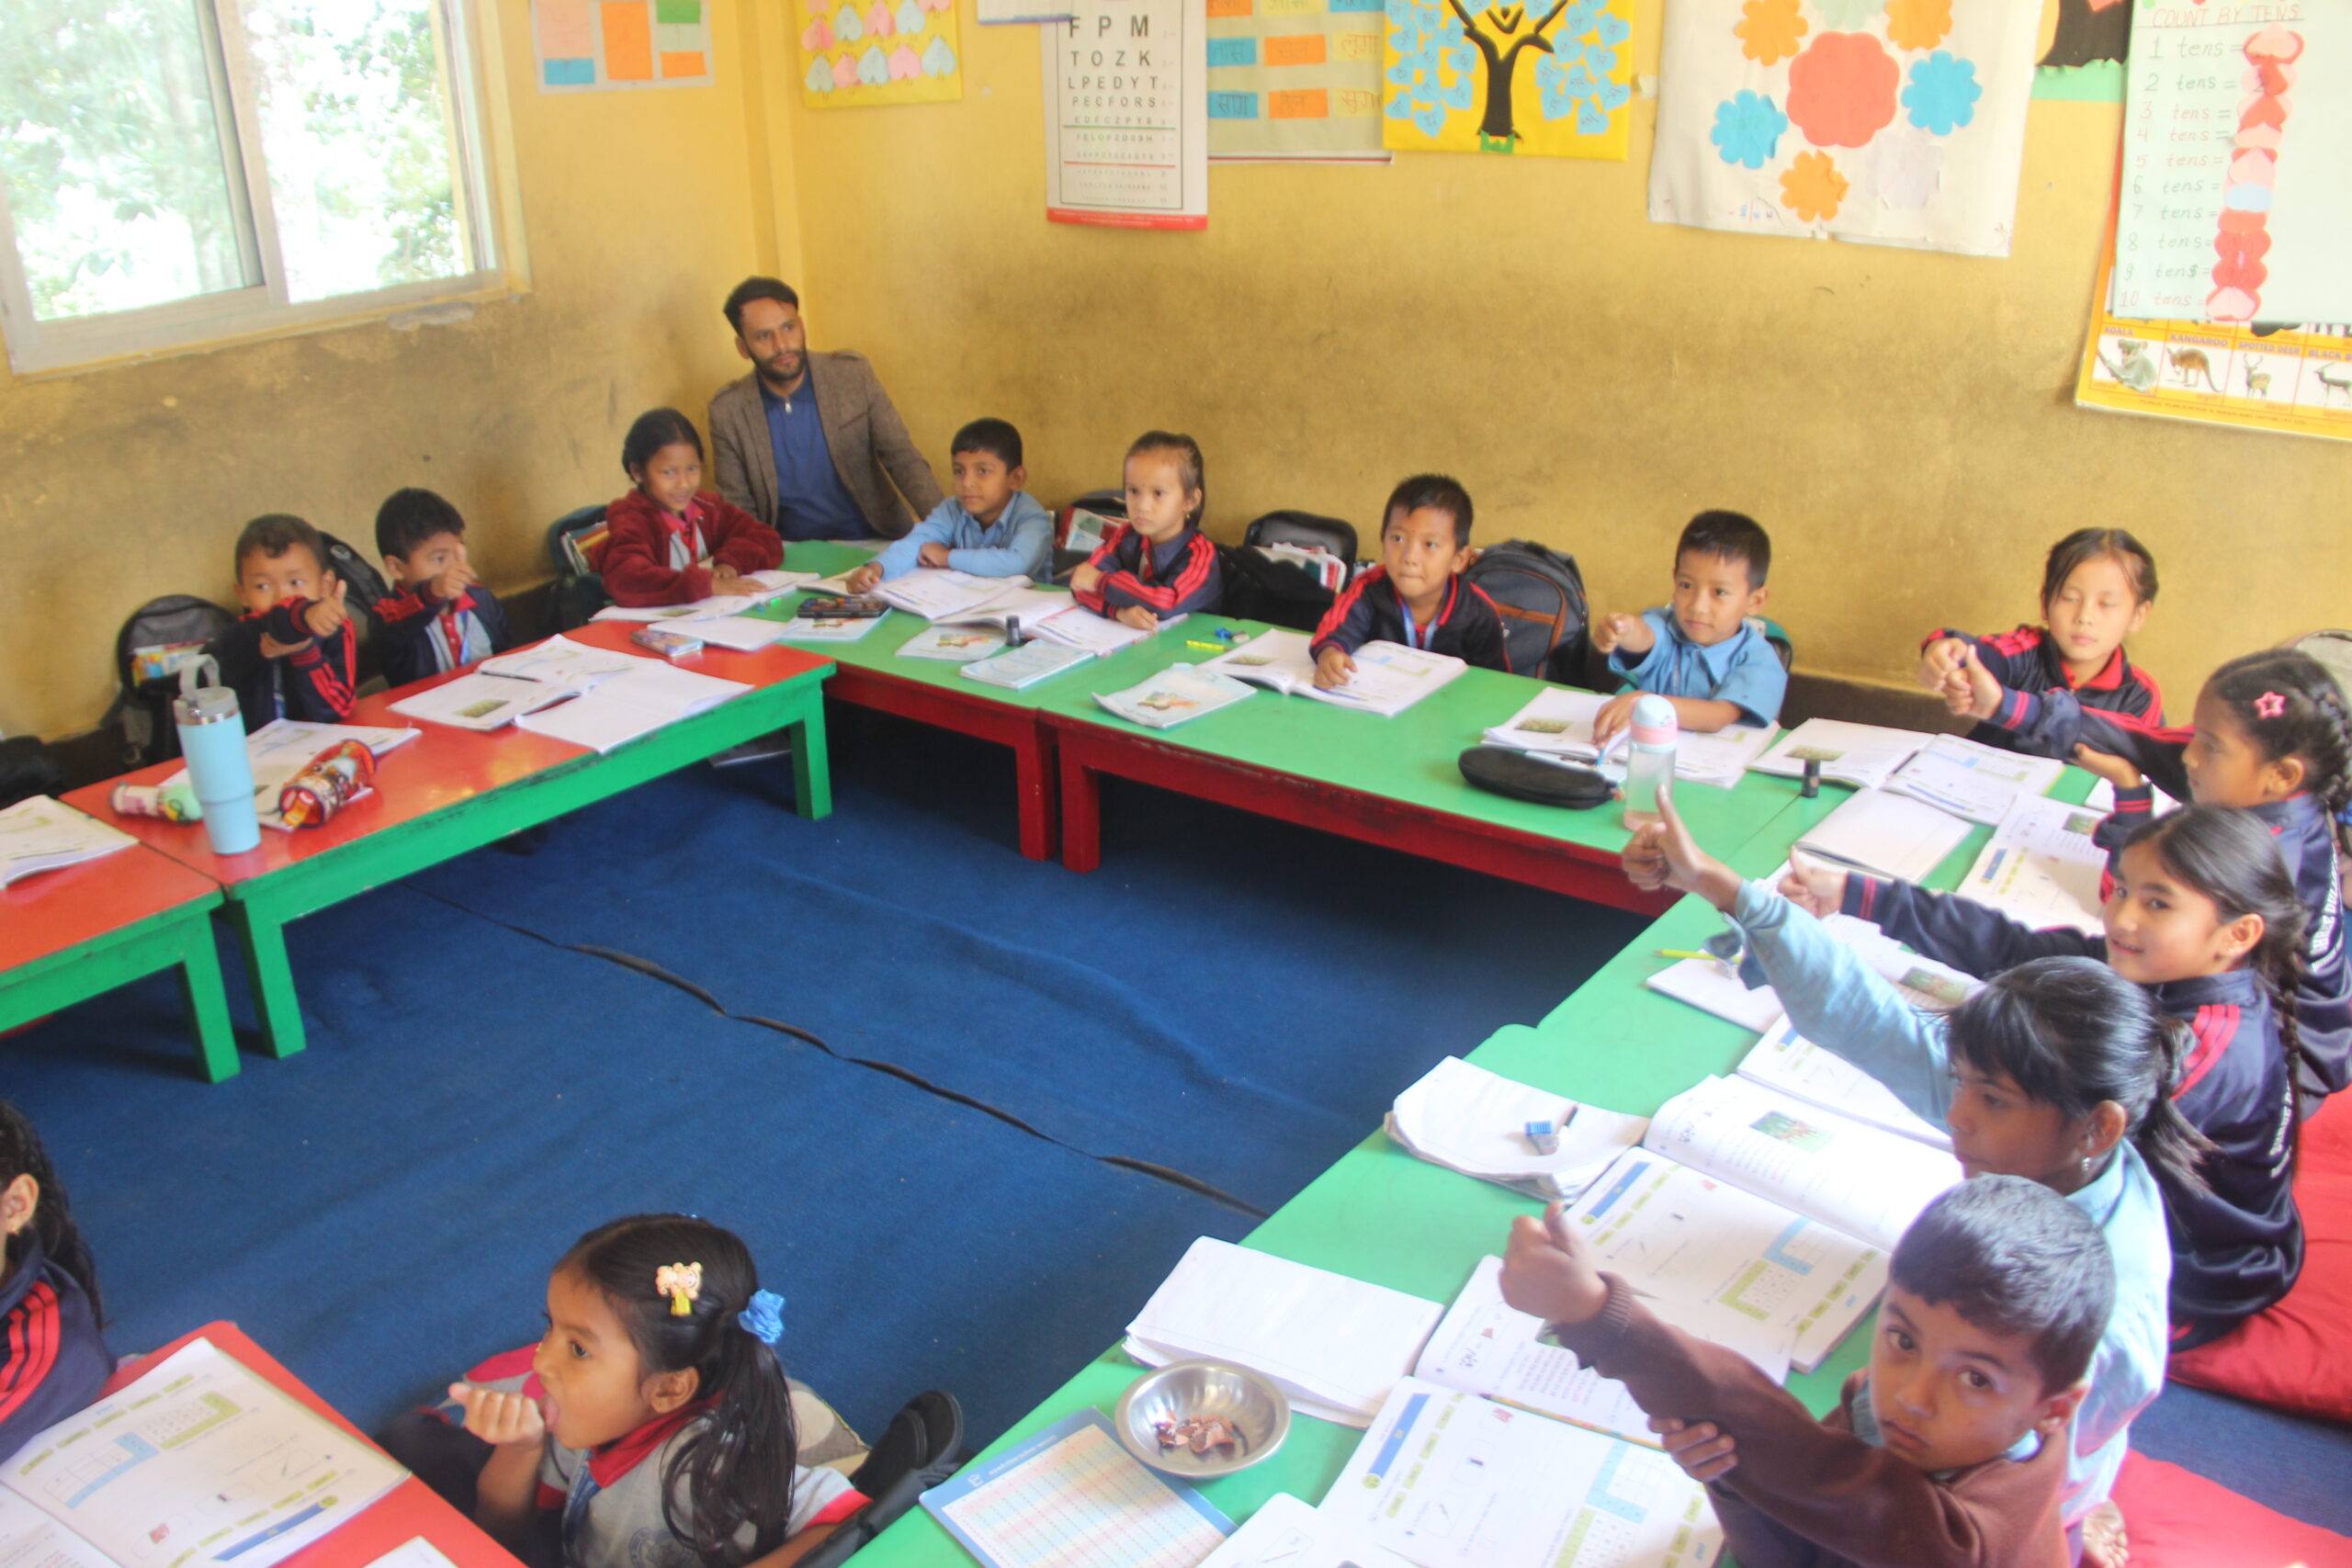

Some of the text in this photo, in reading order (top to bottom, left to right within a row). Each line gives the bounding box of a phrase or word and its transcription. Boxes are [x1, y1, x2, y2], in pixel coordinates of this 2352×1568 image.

[2153, 4, 2301, 28] COUNT BY TENS
[2148, 36, 2164, 60] 1
[2177, 36, 2223, 59] tens
[2143, 73, 2160, 92] 2
[2176, 73, 2217, 91] tens
[2140, 100, 2153, 120] 3
[2172, 103, 2210, 120] tens
[2137, 128, 2148, 142] 4
[2169, 128, 2210, 142] tens
[2133, 154, 2148, 169] 5
[2167, 152, 2209, 167] tens
[2133, 175, 2143, 195] 6
[2162, 179, 2205, 195] tens
[2132, 203, 2143, 221] 7
[2160, 205, 2203, 220] tens
[2128, 231, 2139, 252] 8
[2157, 232, 2202, 250] tens
[2119, 290, 2140, 308] 10
[2154, 291, 2193, 307] tens
[2104, 326, 2134, 336] KOALA
[2170, 333, 2228, 347] KANGAROO
[2238, 340, 2275, 353] SPOTTED
[2308, 348, 2342, 359] BLACK
